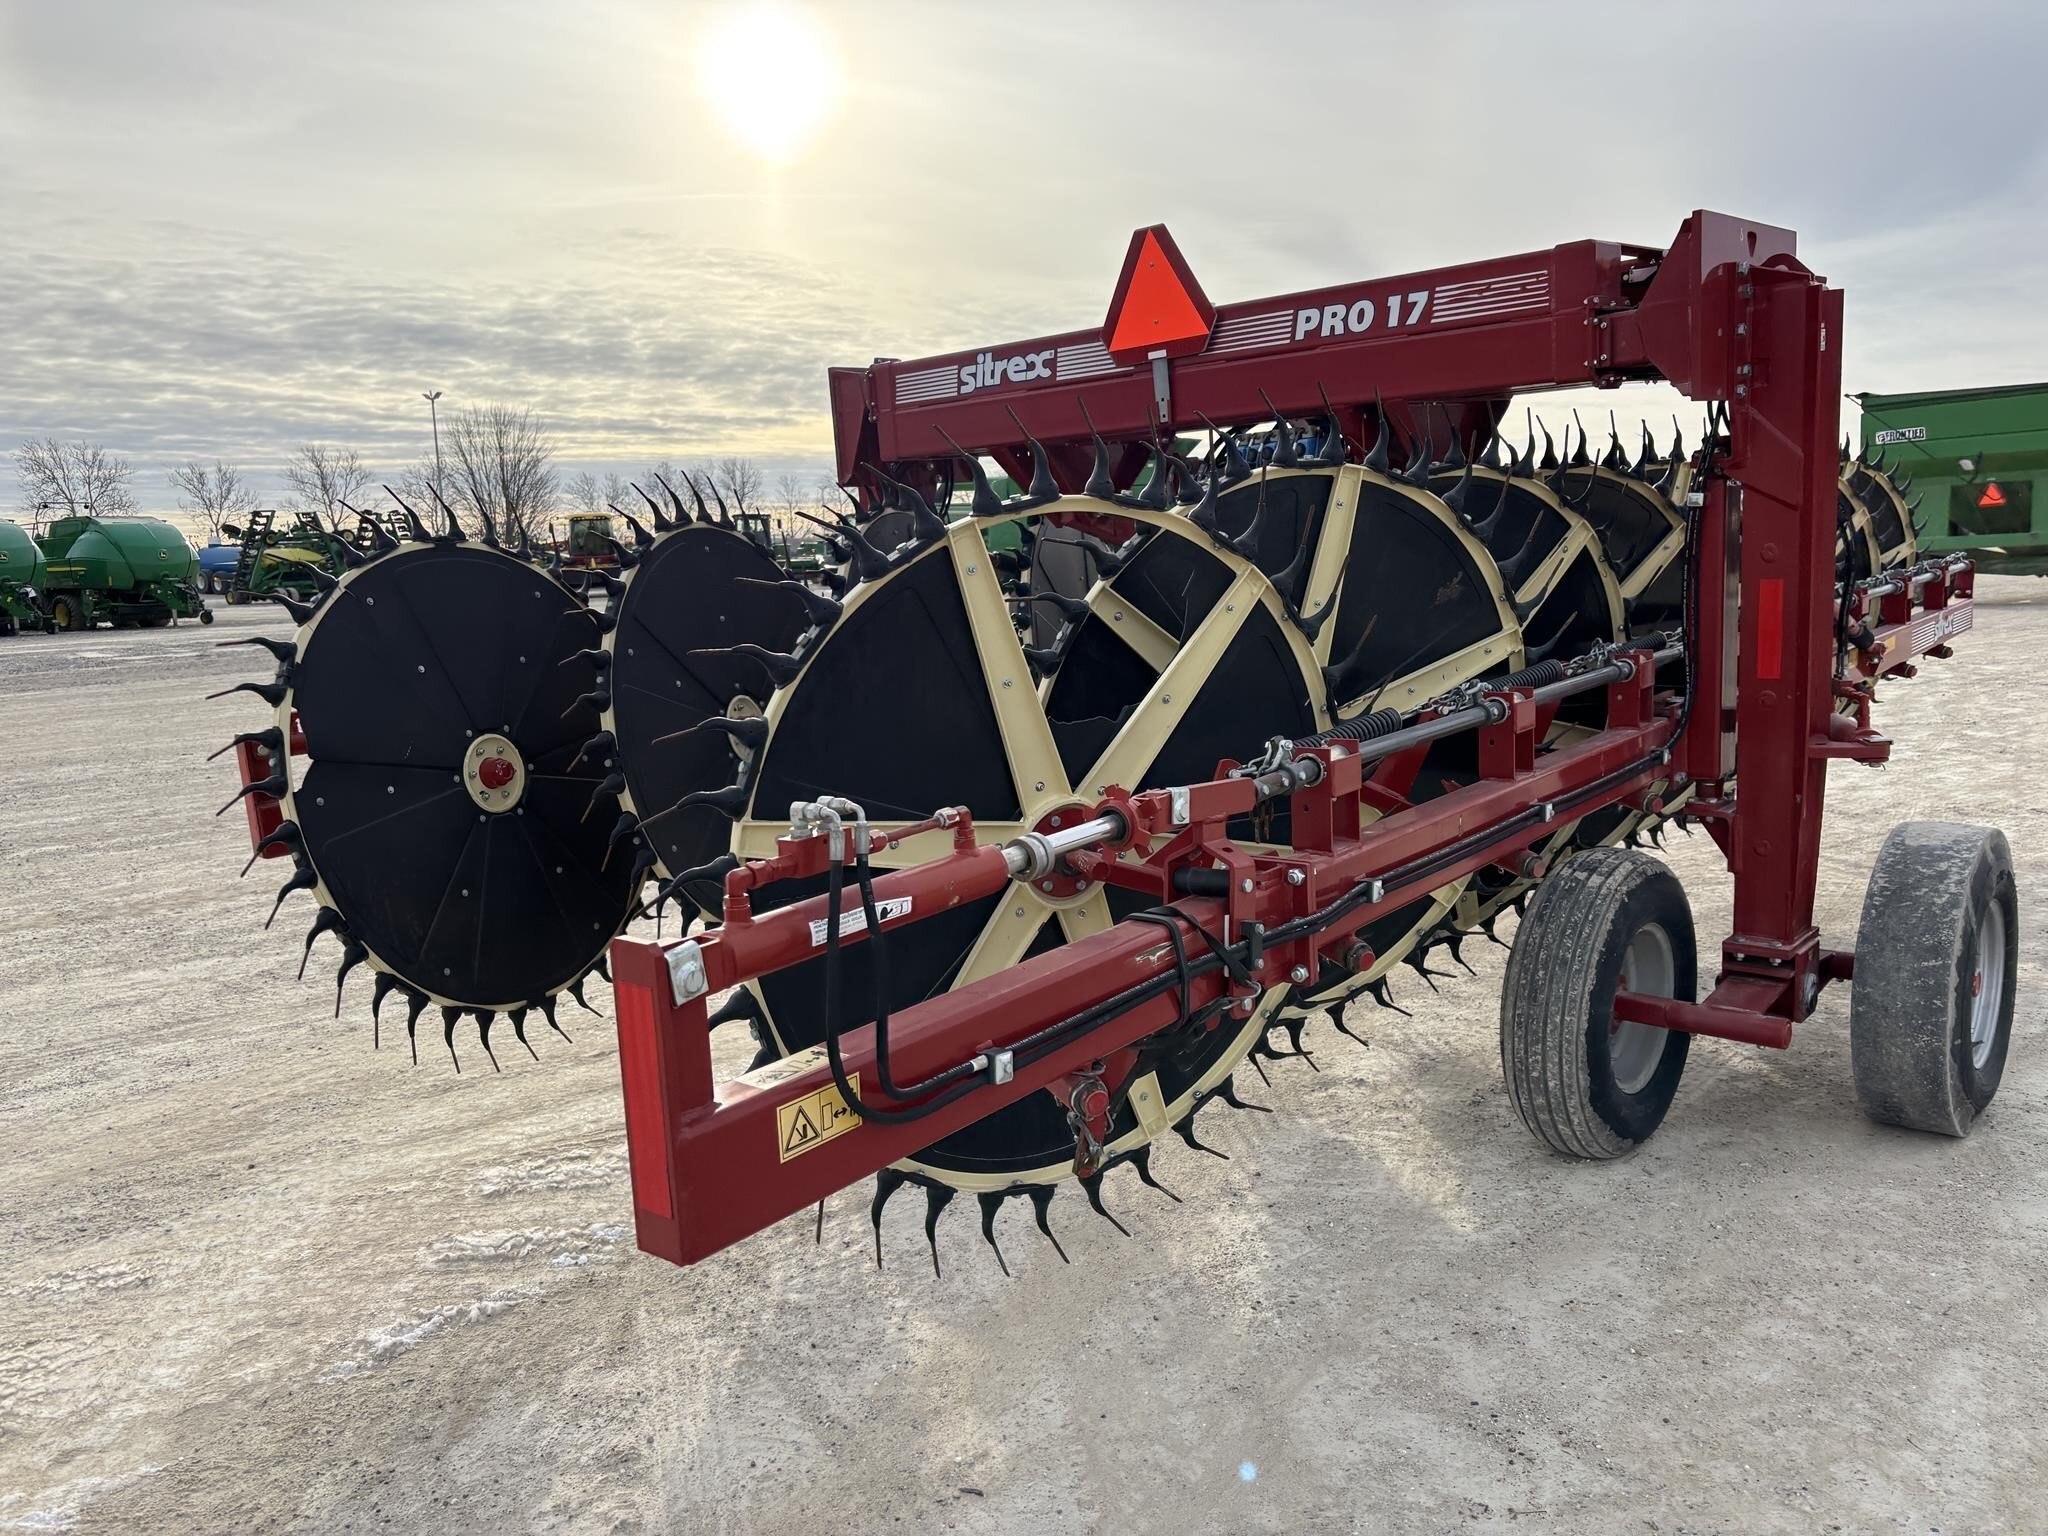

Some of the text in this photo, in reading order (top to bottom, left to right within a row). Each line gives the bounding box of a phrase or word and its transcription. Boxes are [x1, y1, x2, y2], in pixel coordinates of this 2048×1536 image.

[1294, 290, 1429, 341] PRO 17
[960, 349, 1055, 394] sitrex
[1885, 428, 1925, 442] FRONTIER
